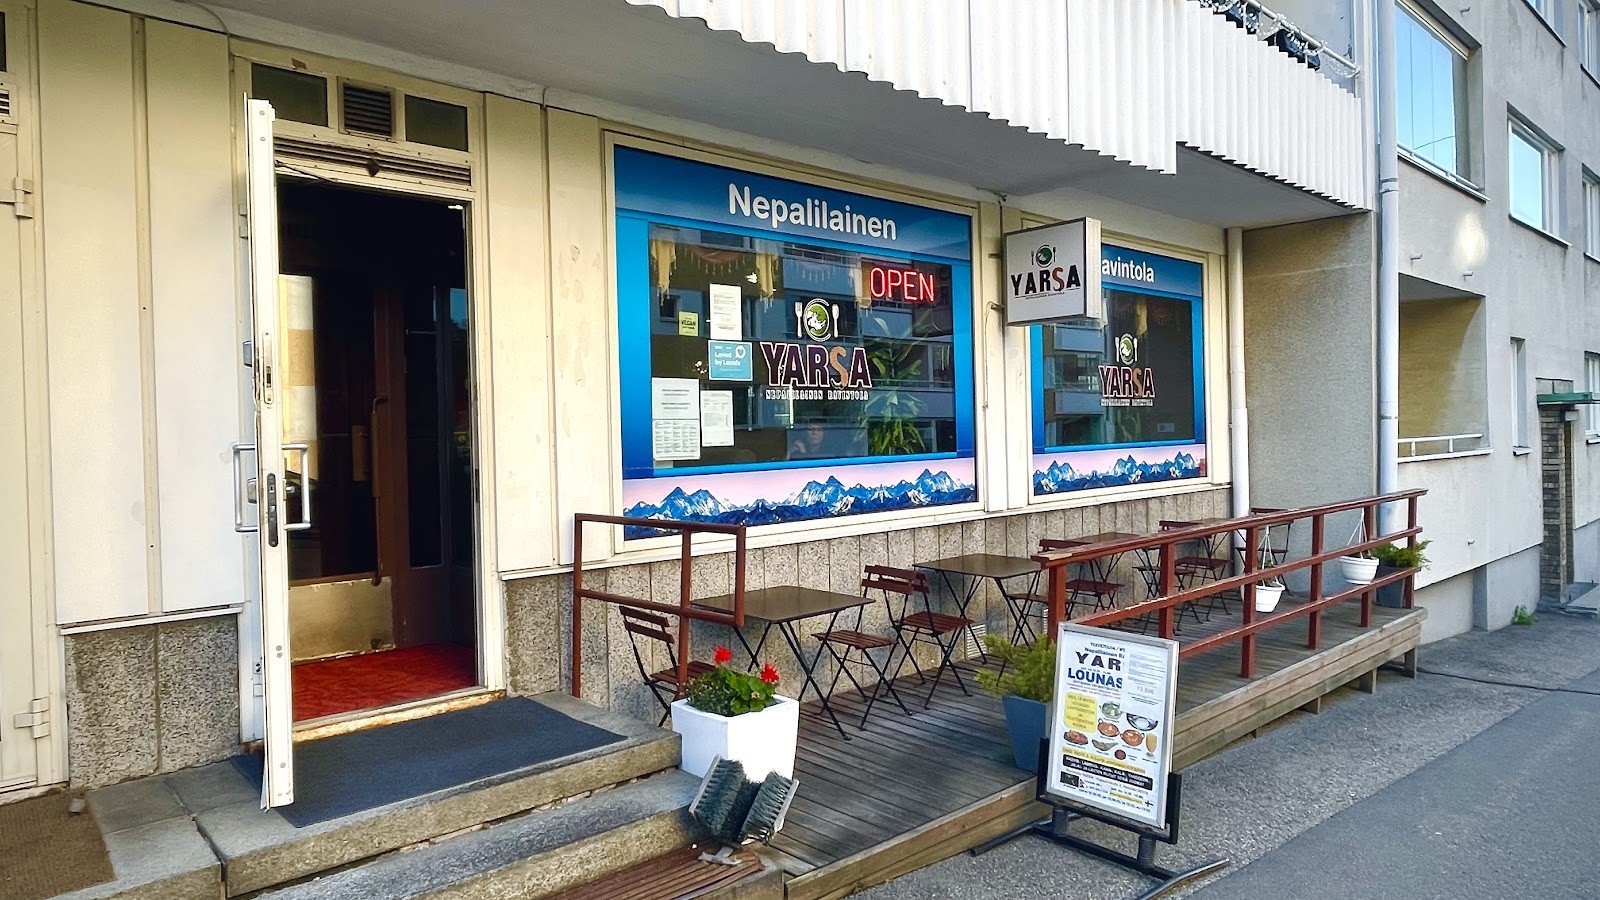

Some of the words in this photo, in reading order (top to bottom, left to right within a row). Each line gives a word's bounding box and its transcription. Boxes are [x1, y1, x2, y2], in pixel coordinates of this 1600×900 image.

[728, 183, 896, 240] Nepalilainen
[869, 266, 935, 302] OPEN
[1010, 264, 1081, 296] YARSA
[1101, 256, 1155, 283] avintola
[714, 359, 722, 367] by
[760, 341, 873, 390] YARSA
[1098, 365, 1156, 398] YARSA
[1075, 650, 1122, 671] YAR
[1067, 667, 1123, 689] LOUNAS
